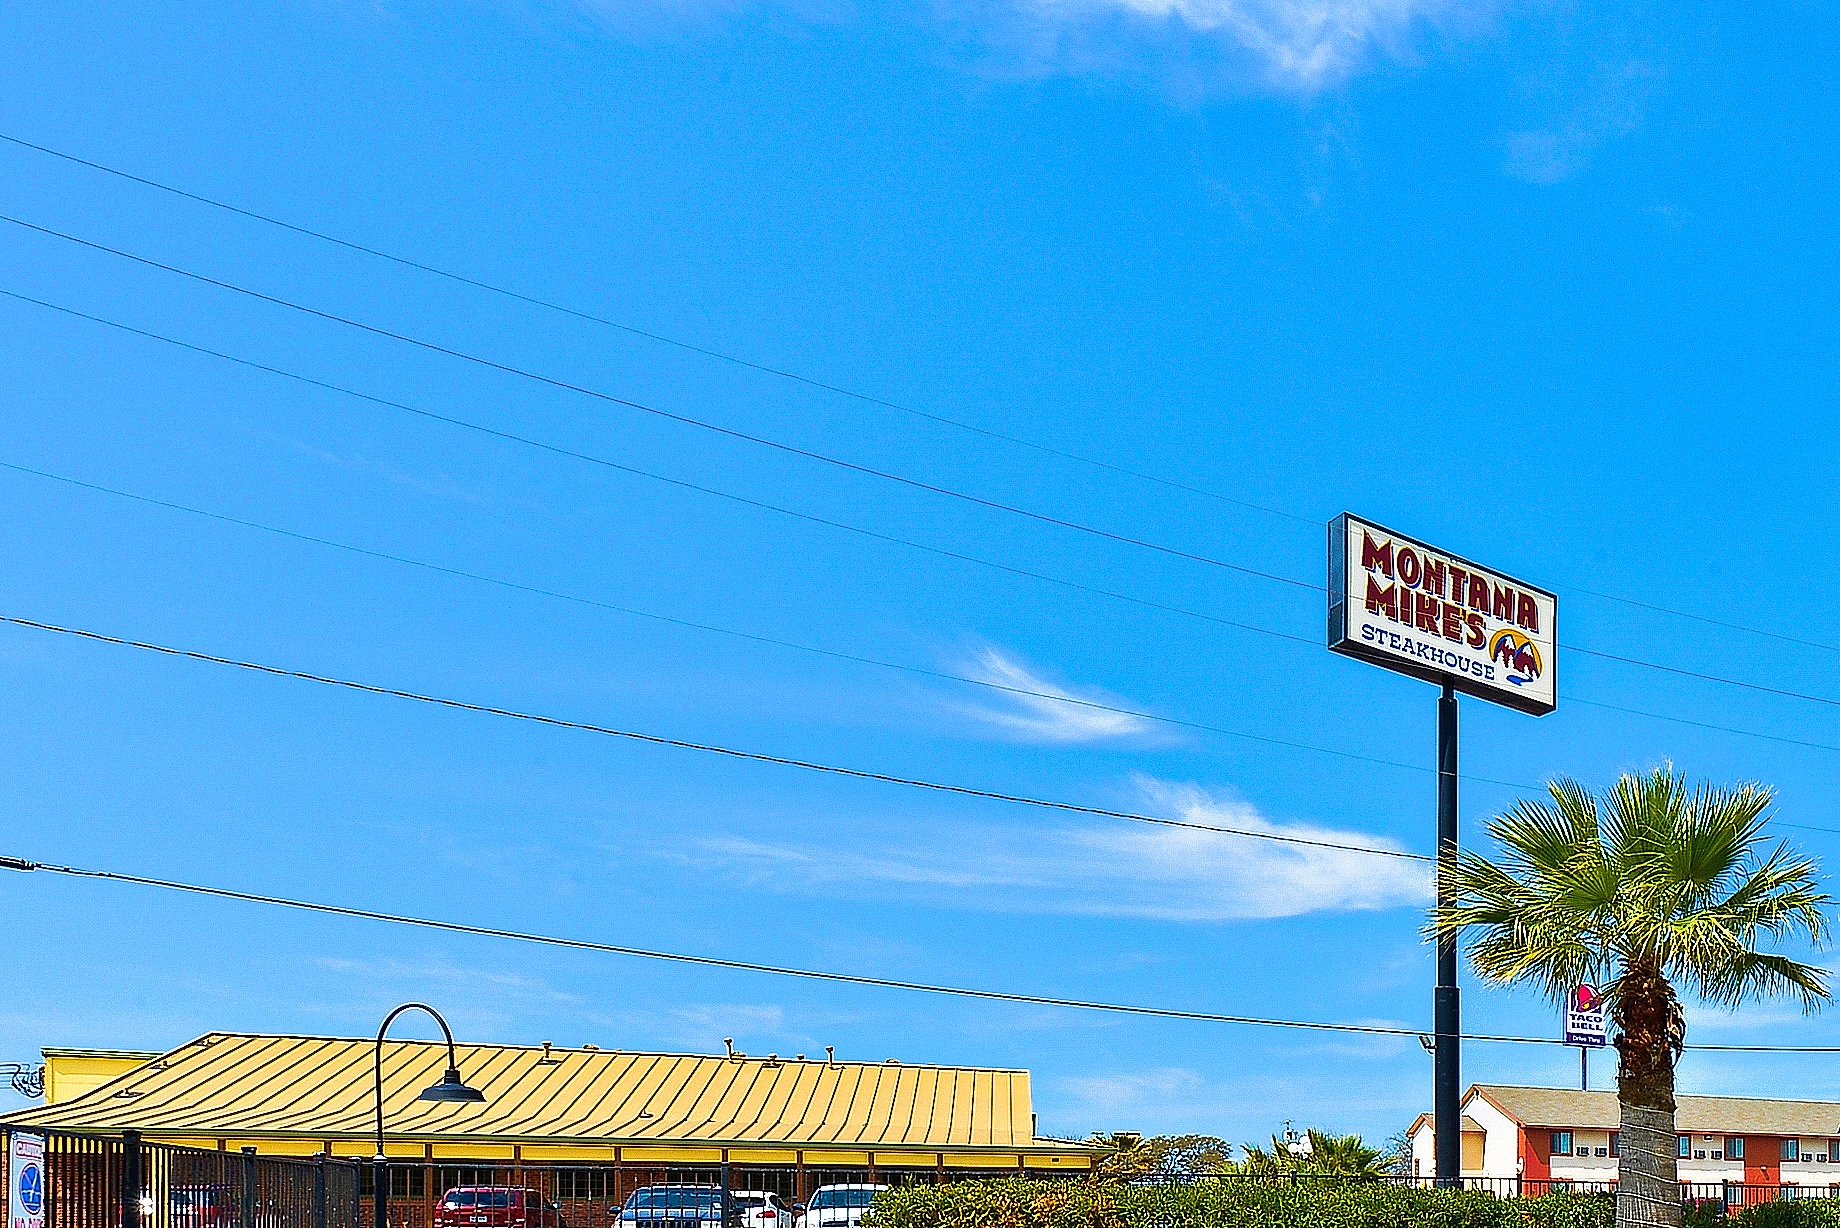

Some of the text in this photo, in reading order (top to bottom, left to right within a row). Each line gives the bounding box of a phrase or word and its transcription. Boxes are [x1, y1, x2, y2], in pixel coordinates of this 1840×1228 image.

[1361, 529, 1539, 633] MONTANA
[1364, 572, 1487, 650] MIKE'S
[1361, 624, 1495, 680] STEAKHOUSE
[1569, 1013, 1603, 1023] TACO
[1571, 1022, 1603, 1031] BELL
